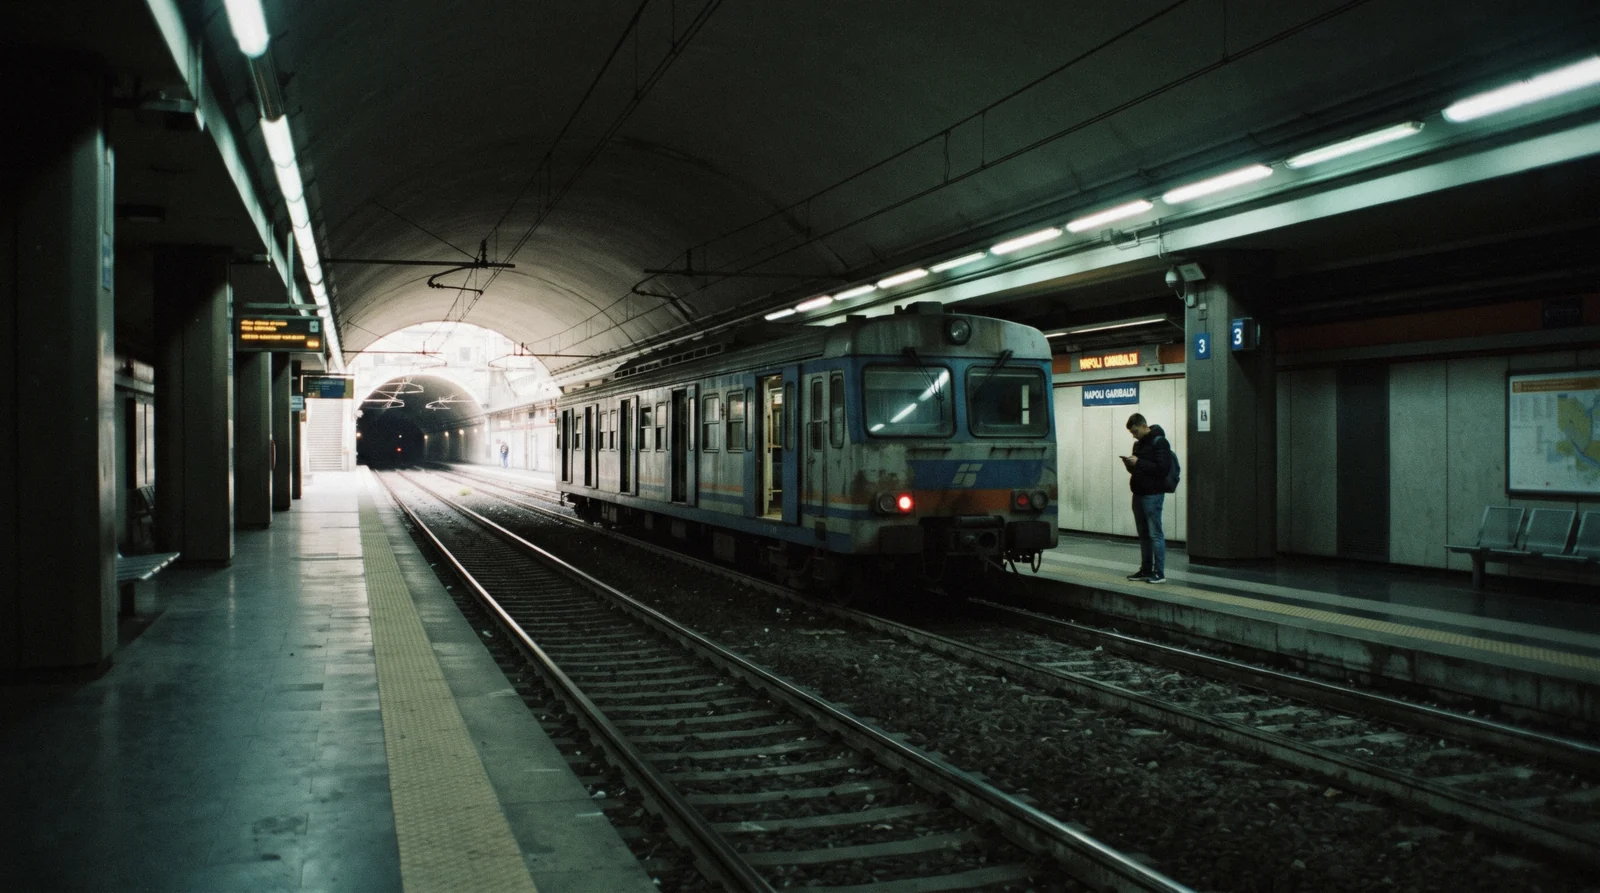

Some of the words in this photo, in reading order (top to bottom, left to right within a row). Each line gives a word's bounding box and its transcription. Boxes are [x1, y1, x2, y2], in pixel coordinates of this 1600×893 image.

[1234, 328, 1242, 345] 3
[1199, 339, 1206, 354] 3
[1084, 389, 1104, 400] NAPOLI
[1105, 387, 1137, 399] GARIBALDI
